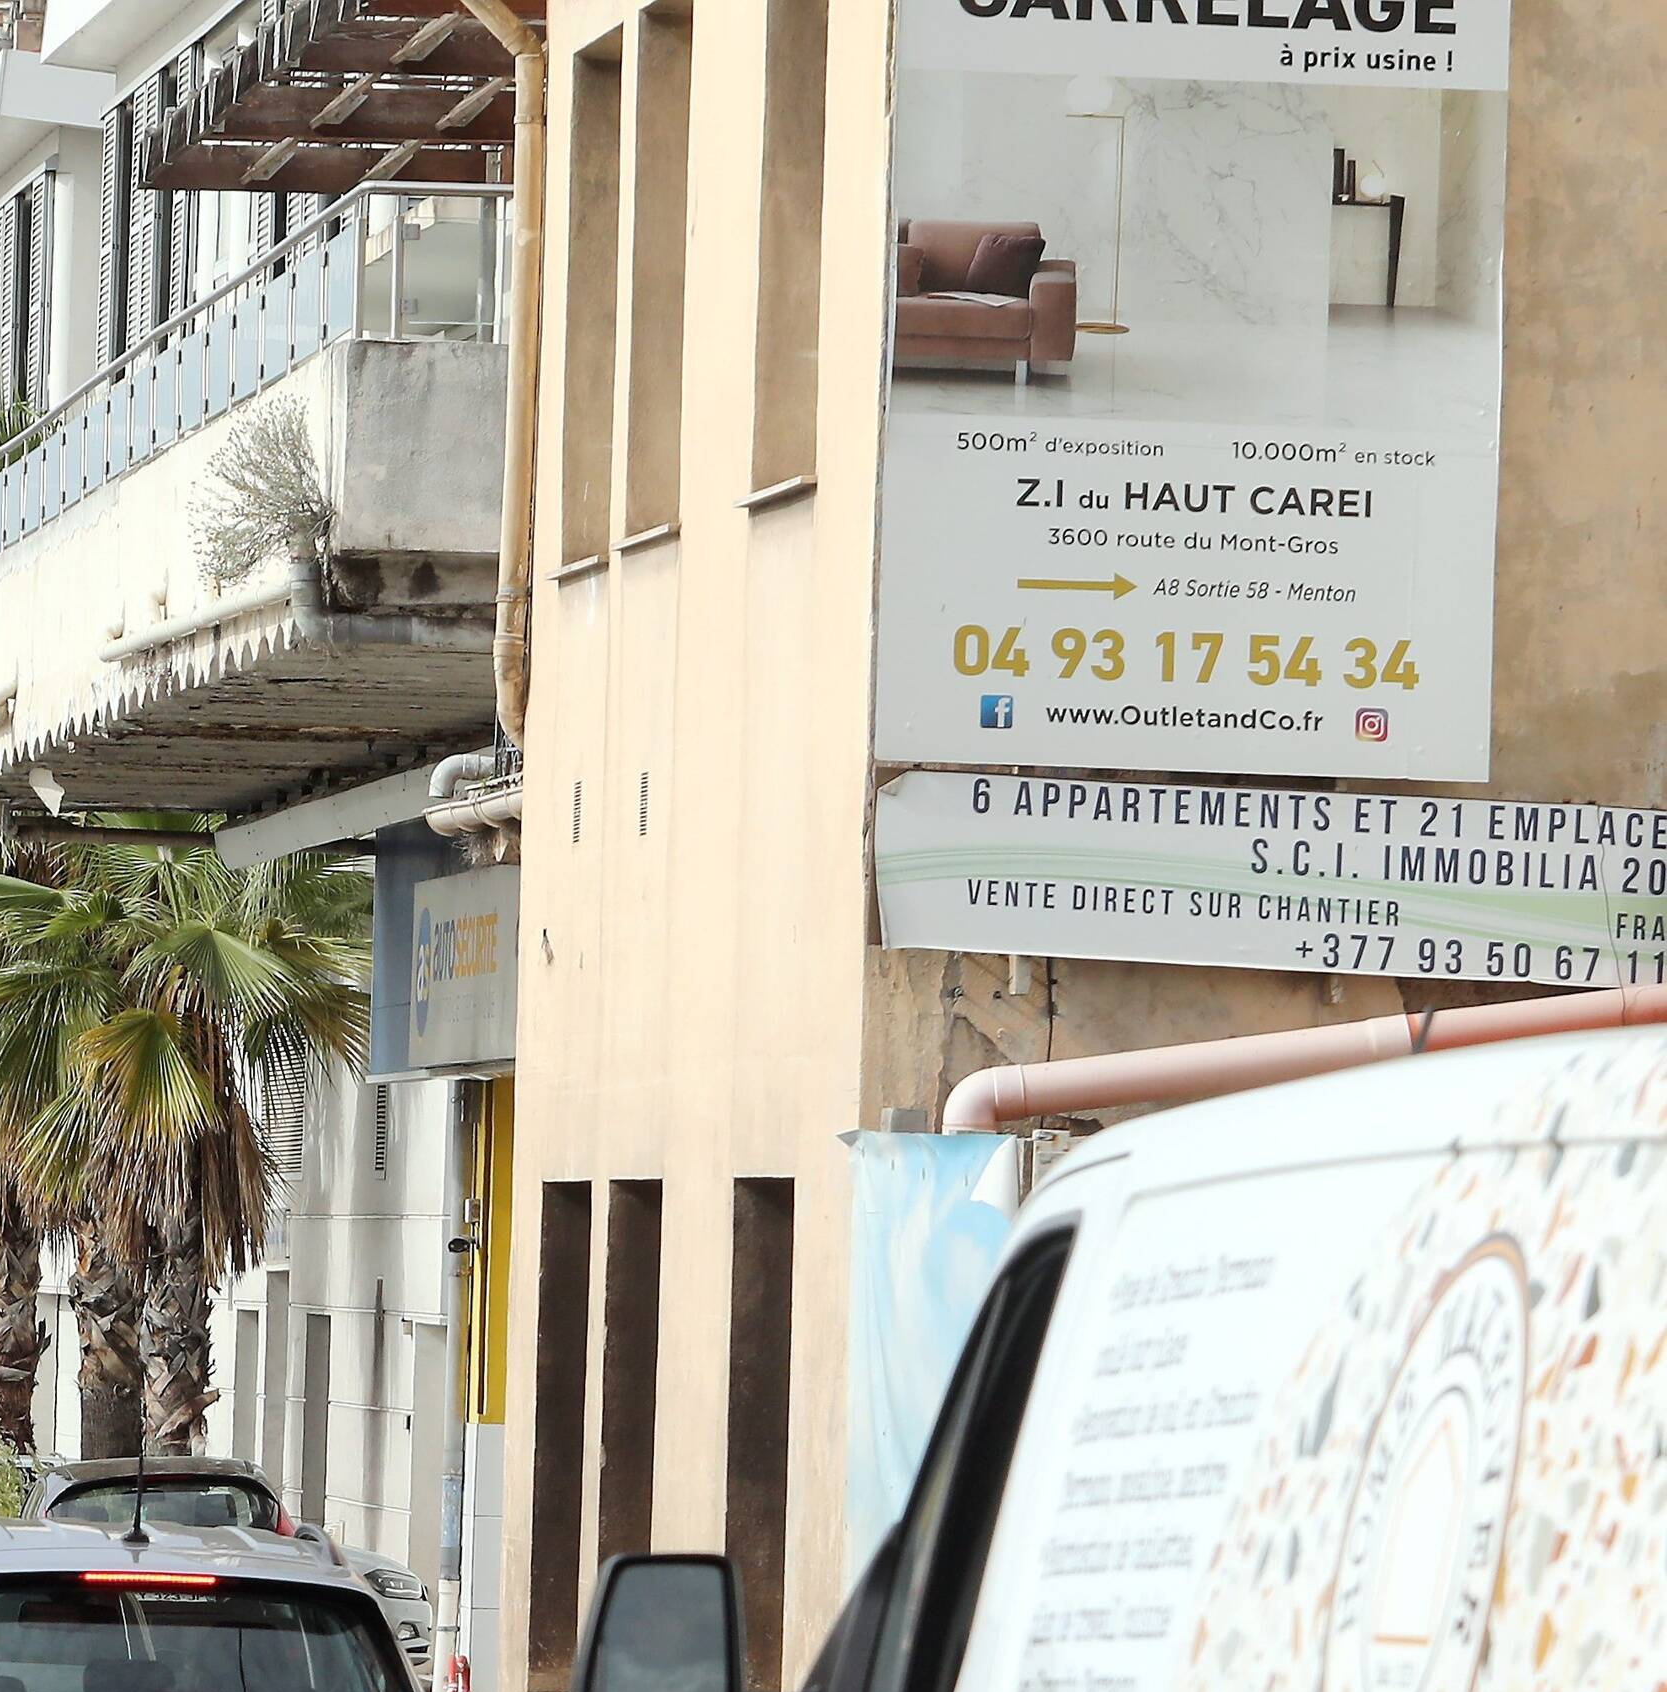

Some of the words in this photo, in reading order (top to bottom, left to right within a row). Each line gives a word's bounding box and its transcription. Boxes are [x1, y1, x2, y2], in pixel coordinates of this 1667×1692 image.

[1280, 43, 1294, 66] à
[1304, 46, 1356, 73] prix
[1366, 48, 1437, 71] usine
[1354, 450, 1377, 465] en
[1382, 449, 1437, 468] stock
[1016, 478, 1065, 508] Z.I
[1078, 489, 1110, 510] du
[1123, 481, 1236, 514] HAUT
[1249, 486, 1373, 519] CAREI
[1048, 527, 1108, 548] 3600
[1116, 530, 1175, 550] route
[1184, 531, 1212, 551] du
[1219, 533, 1340, 555] Mont-Gros
[1152, 577, 1180, 596] A8
[1184, 579, 1240, 599] Sortie
[1245, 581, 1270, 600] 58
[1287, 583, 1357, 602] Menton
[953, 623, 1030, 677] 04
[1051, 627, 1126, 681] 93
[1154, 631, 1224, 683] 17
[1247, 635, 1322, 687] 54
[1343, 637, 1420, 690] 34
[1046, 704, 1323, 733] www.OutletandCo.fr
[973, 778, 991, 814] 6
[1014, 781, 1331, 832] APPARTEMENTS
[1355, 798, 1397, 835] ET
[1420, 801, 1463, 838] 21
[1489, 805, 1667, 850] EMPLACE
[1251, 838, 1359, 879] S.C.I.
[1383, 844, 1599, 892] IMMOBILIA
[1622, 856, 1666, 896] 20
[967, 878, 1056, 909] VENTE
[1072, 885, 1173, 916] DIRECT
[1190, 891, 1241, 919] SUR
[1258, 894, 1400, 927] CHANTIER
[1616, 912, 1666, 942] FRA
[1295, 933, 1395, 971] +377
[1418, 938, 1463, 975] 93
[1486, 941, 1532, 978] 50
[1555, 944, 1600, 982] 67
[1627, 949, 1666, 985] 11
